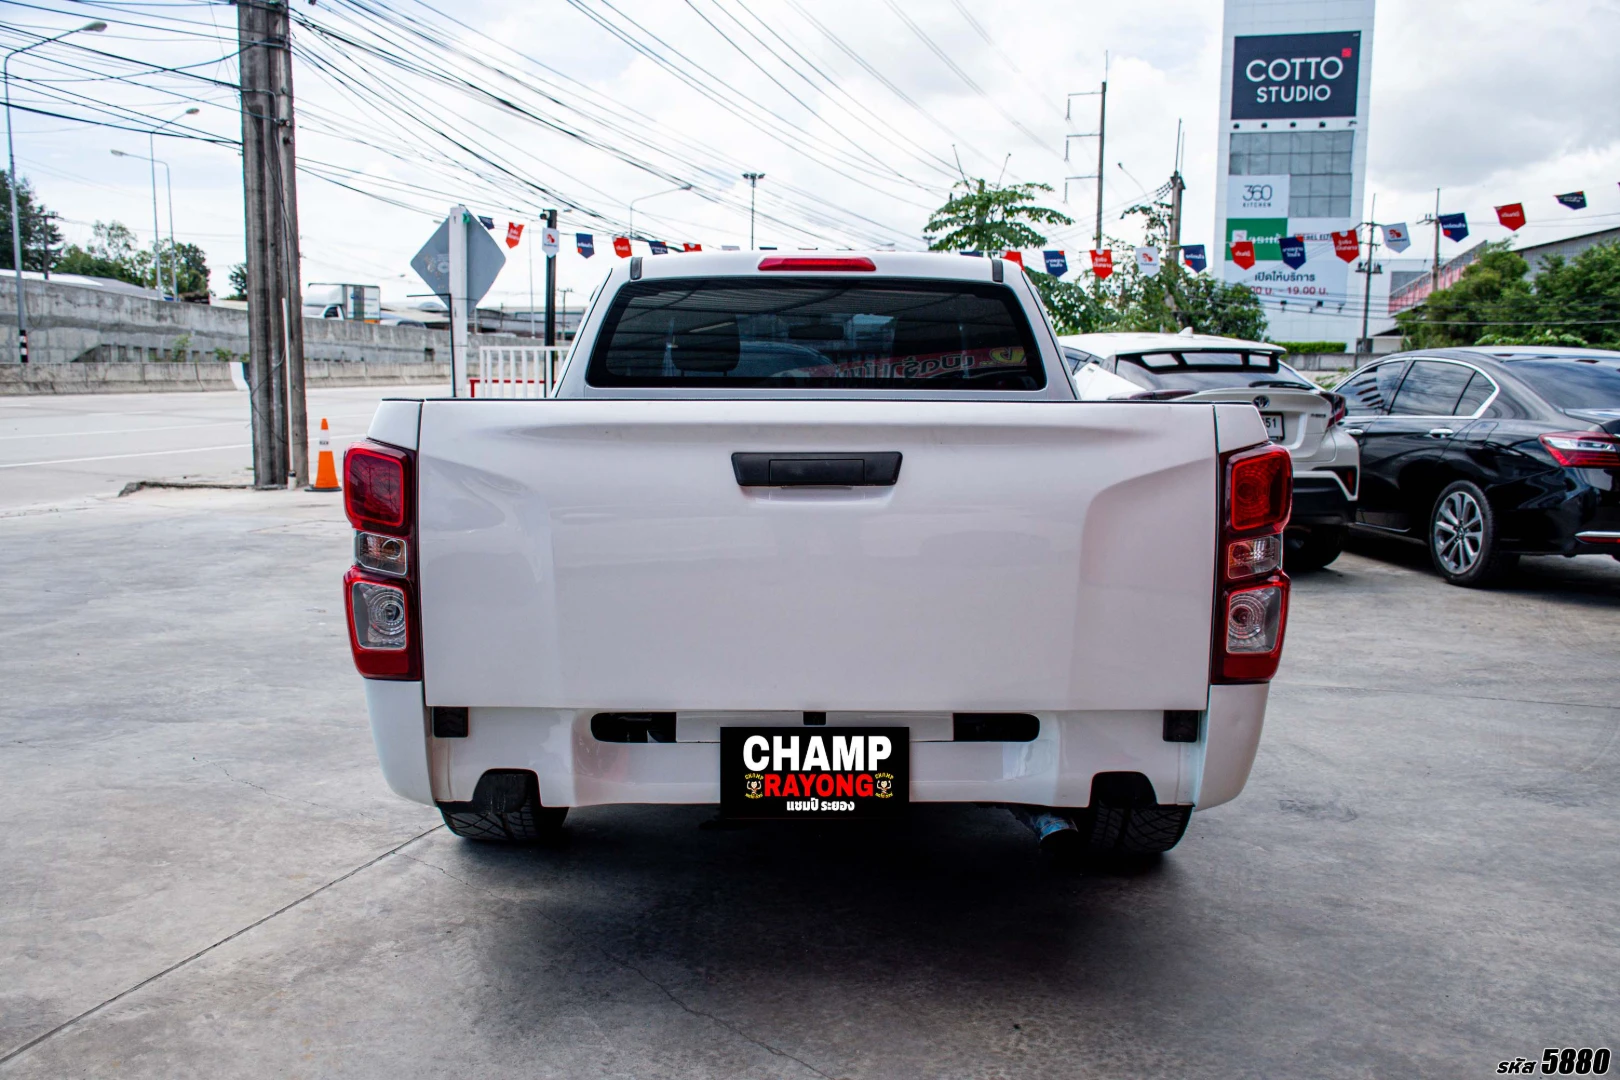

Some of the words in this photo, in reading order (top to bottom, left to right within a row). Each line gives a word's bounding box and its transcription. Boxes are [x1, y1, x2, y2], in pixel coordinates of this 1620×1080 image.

[1246, 56, 1343, 82] COTTO
[1256, 84, 1331, 103] STUDIO
[1243, 185, 1273, 201] 360
[1254, 270, 1316, 282] เปิดให้บริการ
[1287, 286, 1316, 295] 19.00
